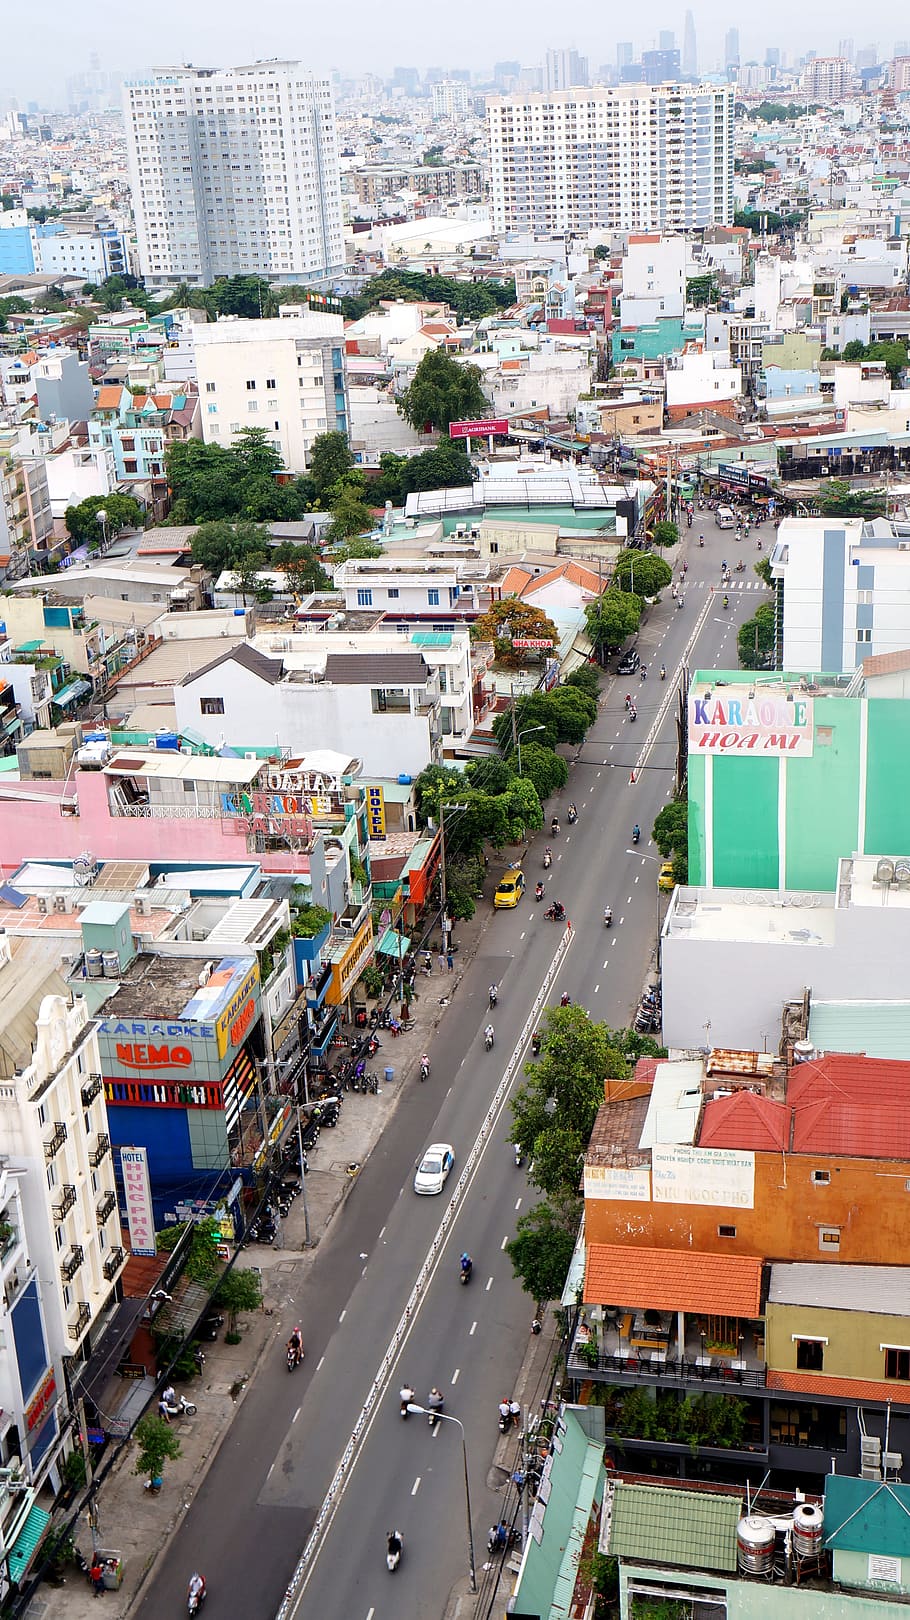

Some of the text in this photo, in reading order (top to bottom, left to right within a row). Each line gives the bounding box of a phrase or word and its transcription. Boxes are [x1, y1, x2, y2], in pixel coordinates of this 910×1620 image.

[694, 699, 807, 727] KARAOKE
[764, 734, 801, 750] MI
[221, 793, 331, 816] KARAOKE
[369, 788, 383, 834] HOTEL
[234, 818, 313, 837] BAMBI
[221, 969, 256, 1033] KARAOKE
[97, 1022, 214, 1038] KARAOKE
[230, 998, 256, 1047] NEMO
[115, 1043, 192, 1067] NEMO
[122, 1153, 144, 1162] HOTEL
